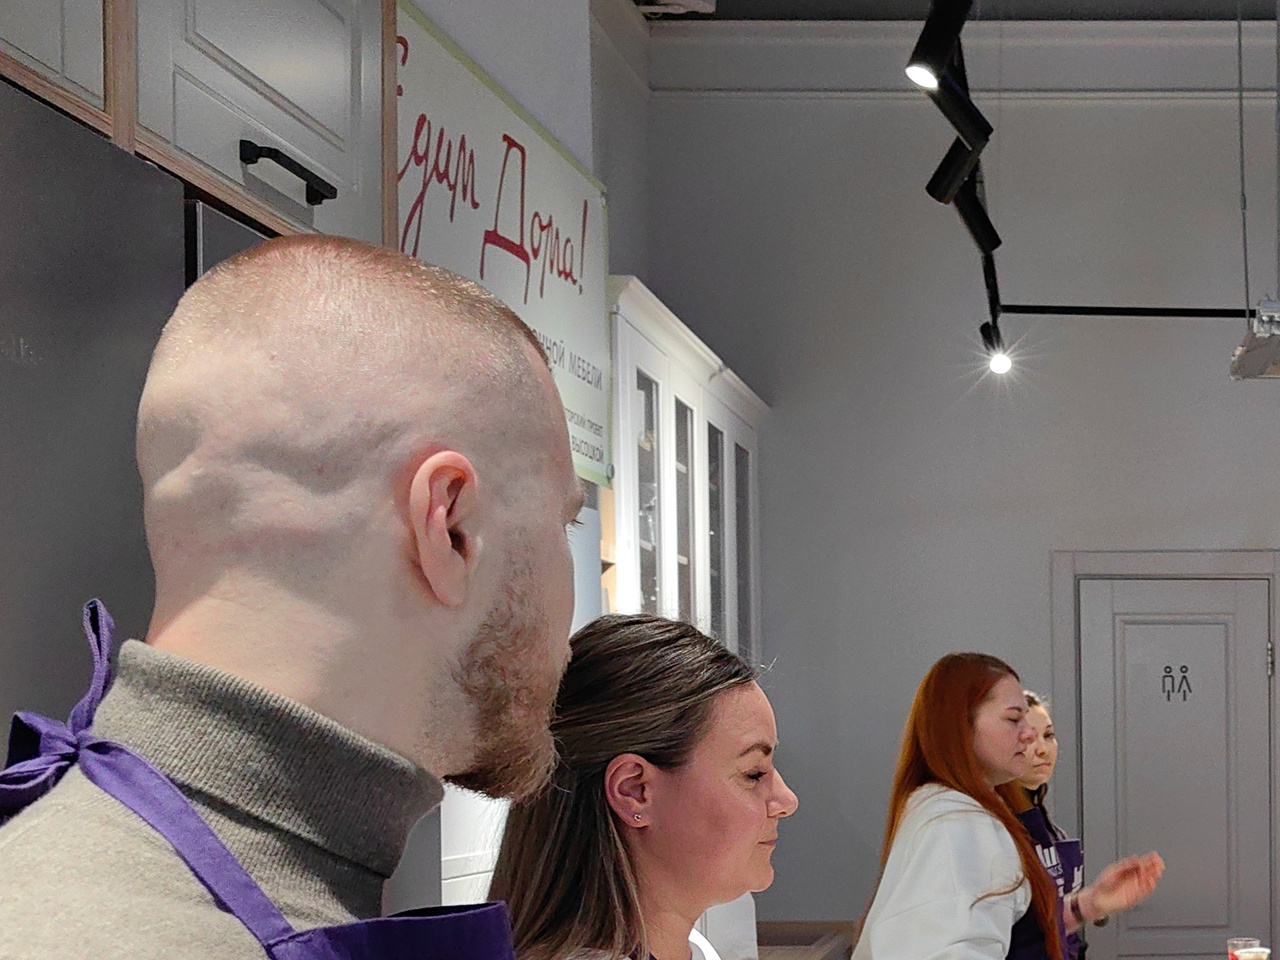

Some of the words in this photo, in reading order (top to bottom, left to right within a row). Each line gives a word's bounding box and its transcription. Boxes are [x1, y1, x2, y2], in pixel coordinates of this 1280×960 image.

[396, 35, 480, 258] дим
[481, 133, 590, 304] Дома!
[568, 351, 603, 390] МЕБЕЛИ
